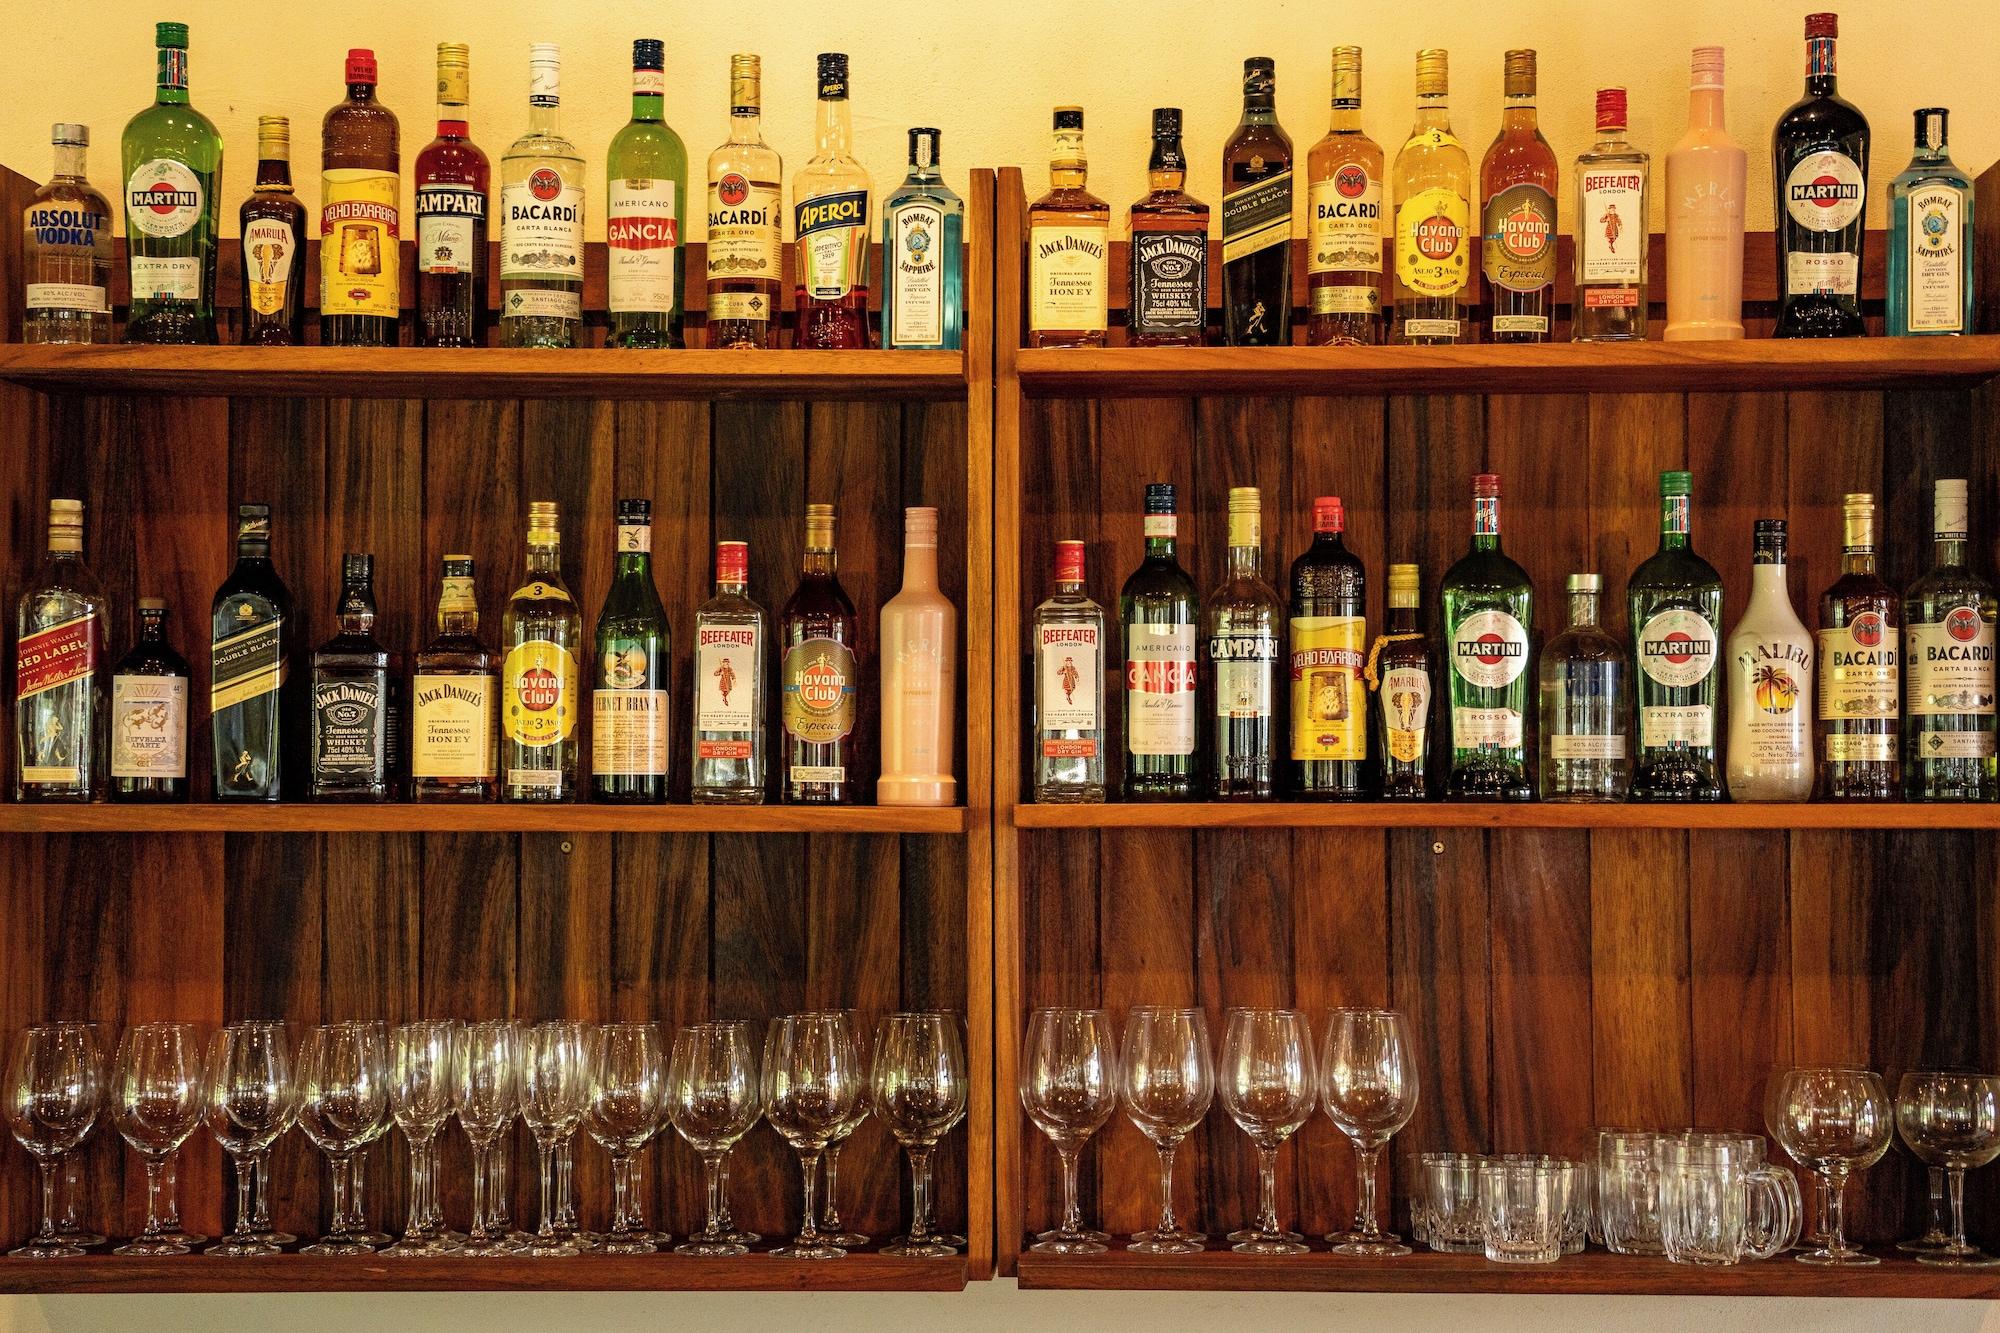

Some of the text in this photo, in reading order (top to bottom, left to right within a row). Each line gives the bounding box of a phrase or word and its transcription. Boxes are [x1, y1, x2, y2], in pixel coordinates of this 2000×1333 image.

[822, 83, 844, 95] APEROL
[1432, 133, 1441, 143] 3
[1585, 175, 1640, 192] BEEFEATER
[133, 191, 196, 206] MARTINI
[1793, 184, 1858, 200] MARTINI
[614, 200, 669, 208] AMERICANO
[1224, 201, 1259, 218] DOUBLE
[1260, 188, 1290, 205] BLACK
[1317, 201, 1380, 219] BACARDÍ
[1917, 196, 1955, 212] BOMBAY
[30, 209, 101, 229] ABSOLUT
[325, 203, 398, 225] VELHO BARREIRO
[512, 204, 577, 224] BACARDÍ
[708, 206, 768, 227] BACARDÍ
[799, 200, 862, 233] APEROL
[901, 213, 935, 229] BOMBAY
[543, 225, 572, 233] BLANCA
[609, 223, 675, 242] GANCIA
[1410, 221, 1463, 238] Havana
[1498, 218, 1549, 233] Havana
[36, 227, 96, 247] VODKA
[248, 227, 289, 245] AMARULA
[1509, 233, 1540, 248] Club
[814, 241, 843, 253] APERITIVO
[1039, 235, 1104, 260] JACK DANIEL'S
[1140, 238, 1204, 263] JACK DANIEL'S
[1420, 237, 1453, 253] Club
[1915, 243, 1955, 258] SAPPHIRE
[821, 252, 835, 261] 1919
[899, 260, 936, 275] SAPPHIRE
[1434, 266, 1443, 278] 3
[1497, 265, 1548, 282] Especial
[1050, 277, 1093, 287] Tennessee
[1150, 278, 1193, 288] Tennessee
[1049, 288, 1093, 296] HONEY
[533, 586, 543, 596] 3
[19, 631, 81, 657] JOHNNIE WALKER
[701, 630, 753, 646] BEEFEATER
[1043, 629, 1096, 645] BEEFEATER
[17, 640, 84, 670] RED LABEL
[214, 638, 280, 666] DOUBLE BLACK
[1210, 638, 1278, 658] CAMPARI
[1458, 643, 1521, 656] MARTINI
[1645, 641, 1711, 655] MARTINI
[1926, 643, 1993, 661] BACARDÍ
[1292, 651, 1363, 669] VELHO BARREIRO
[1737, 643, 1811, 671] MALIBU
[1833, 648, 1897, 666] BACARDÍ
[795, 670, 846, 686] Havana
[1388, 677, 1425, 691] AMARULA
[315, 690, 340, 710] JACK
[418, 683, 482, 708] JACK DANIEL'S
[521, 690, 554, 705] Club
[805, 686, 837, 701] Club
[595, 697, 622, 711] FERNET
[325, 725, 369, 735] Tennessee
[427, 725, 471, 734] Tennessee
[535, 718, 543, 730] 3
[796, 716, 843, 734] Especial
[428, 735, 471, 743] HONEY
